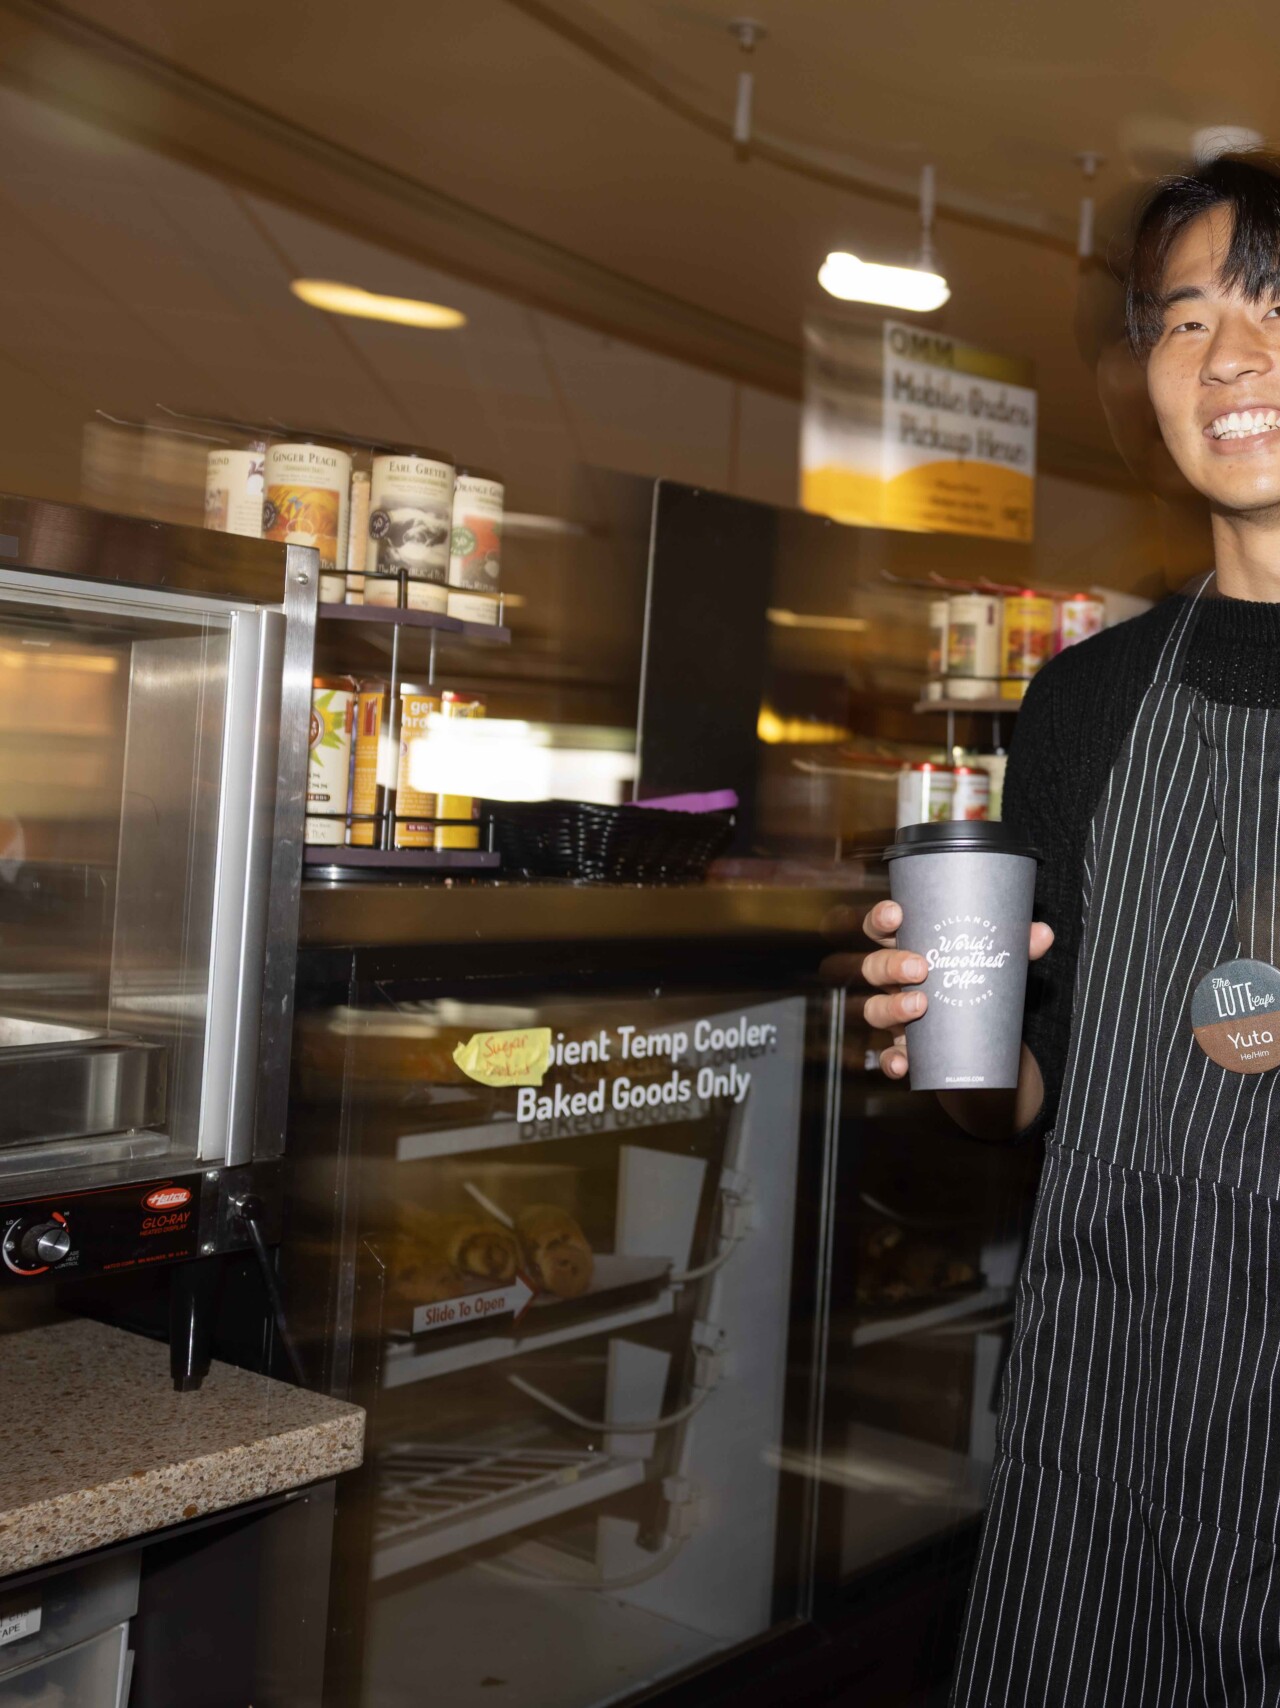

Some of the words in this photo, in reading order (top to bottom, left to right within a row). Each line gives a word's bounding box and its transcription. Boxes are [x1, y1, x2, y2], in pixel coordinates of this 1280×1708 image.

[892, 370, 963, 413] Mobile
[900, 413, 972, 466] Pickup
[976, 428, 1026, 465] Here
[273, 451, 304, 462] GINGER
[309, 453, 337, 467] PEACH
[389, 461, 410, 472] EARL
[934, 915, 998, 933] DILLANOS
[939, 933, 994, 953] World's
[926, 949, 1010, 972] Smoothest
[943, 970, 986, 989] Coffee
[1212, 978, 1231, 990] The
[934, 991, 963, 1007] SINCE
[970, 989, 994, 1006] 1992
[1213, 982, 1255, 1018] LUTE
[1252, 993, 1275, 1007] Café
[617, 1026, 688, 1063] Temp
[694, 1016, 777, 1051] Cooler:
[1227, 1029, 1274, 1049] Yuta
[1240, 1049, 1270, 1061] He/Him
[517, 1078, 605, 1123] Baked
[612, 1070, 690, 1110] Goods
[697, 1064, 751, 1103] Only
[149, 1192, 188, 1206] Hatco
[142, 1212, 191, 1230] GLO-RAY
[425, 1304, 455, 1325] Slide
[459, 1301, 471, 1317] To
[474, 1297, 505, 1315] Open
[0, 1623, 21, 1639] APE
